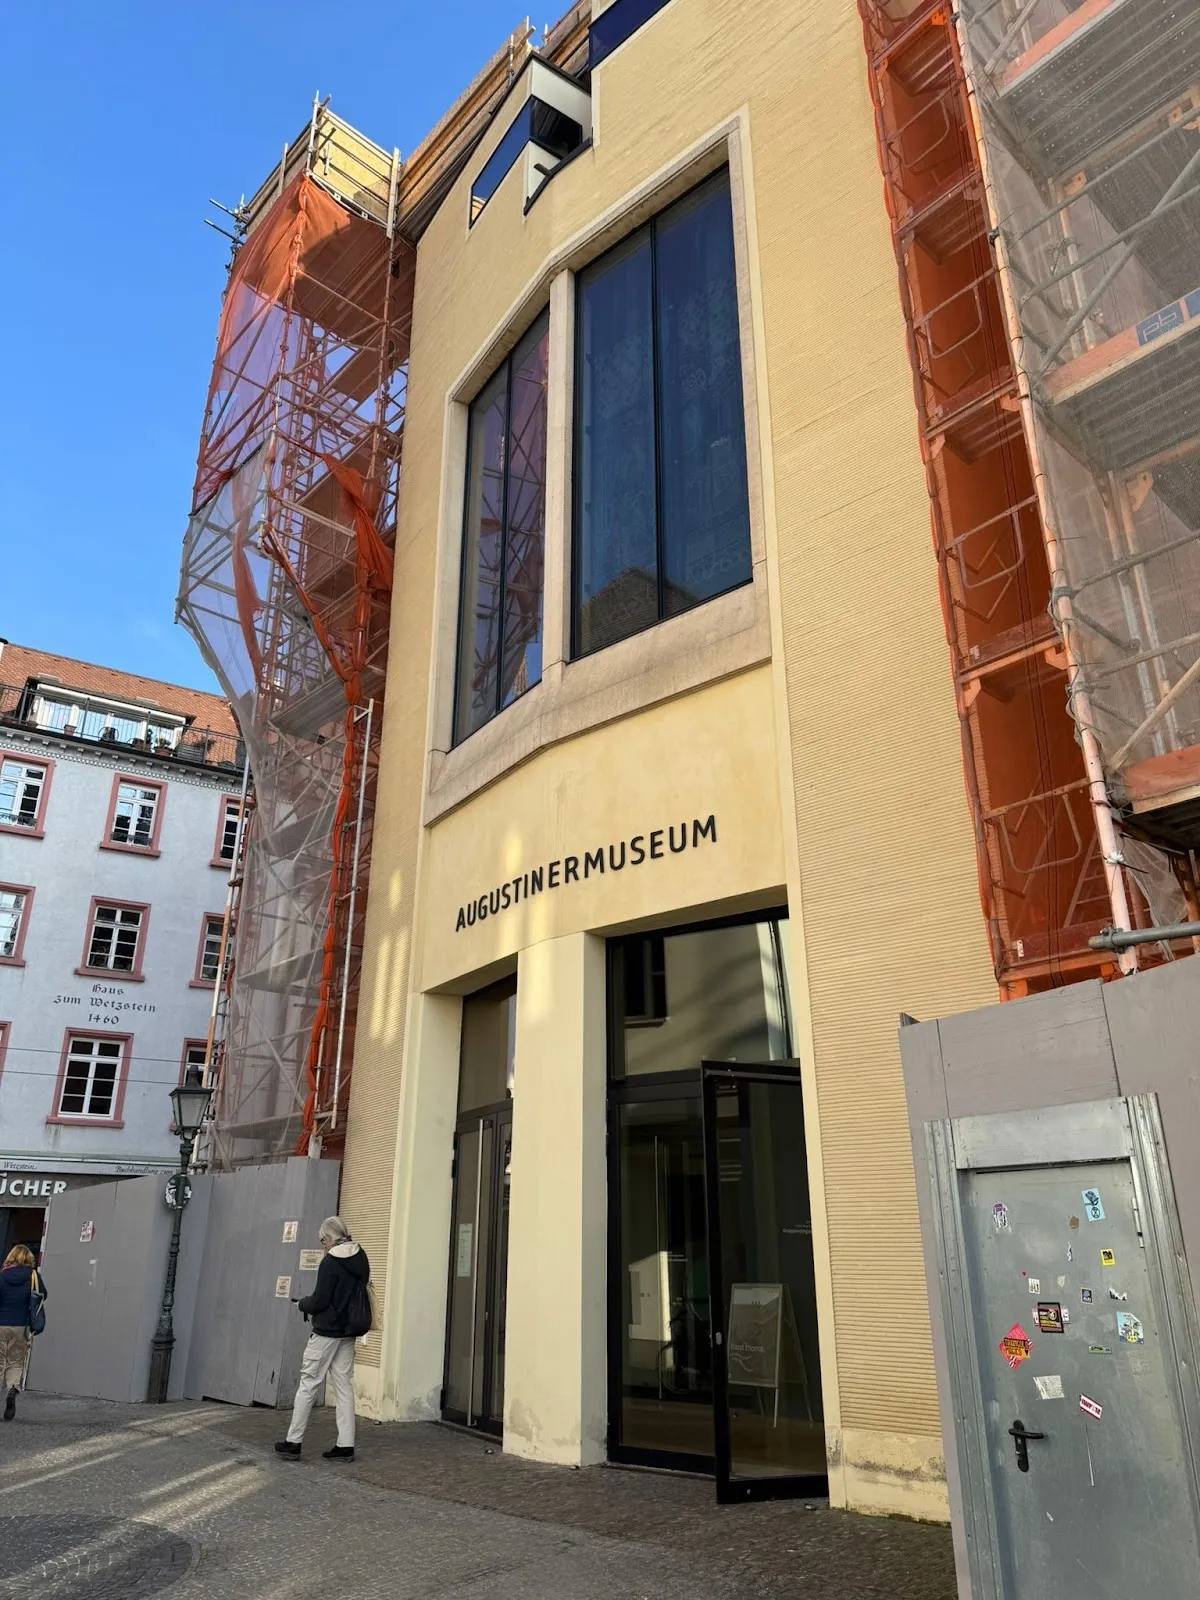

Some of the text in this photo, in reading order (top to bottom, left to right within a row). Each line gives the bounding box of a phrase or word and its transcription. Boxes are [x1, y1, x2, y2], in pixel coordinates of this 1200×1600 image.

[456, 814, 717, 932] AUGUSTINERMUSEUM
[92, 984, 124, 995] Haus
[53, 995, 156, 1012] zum Wetzstein
[88, 1013, 119, 1025] 1460
